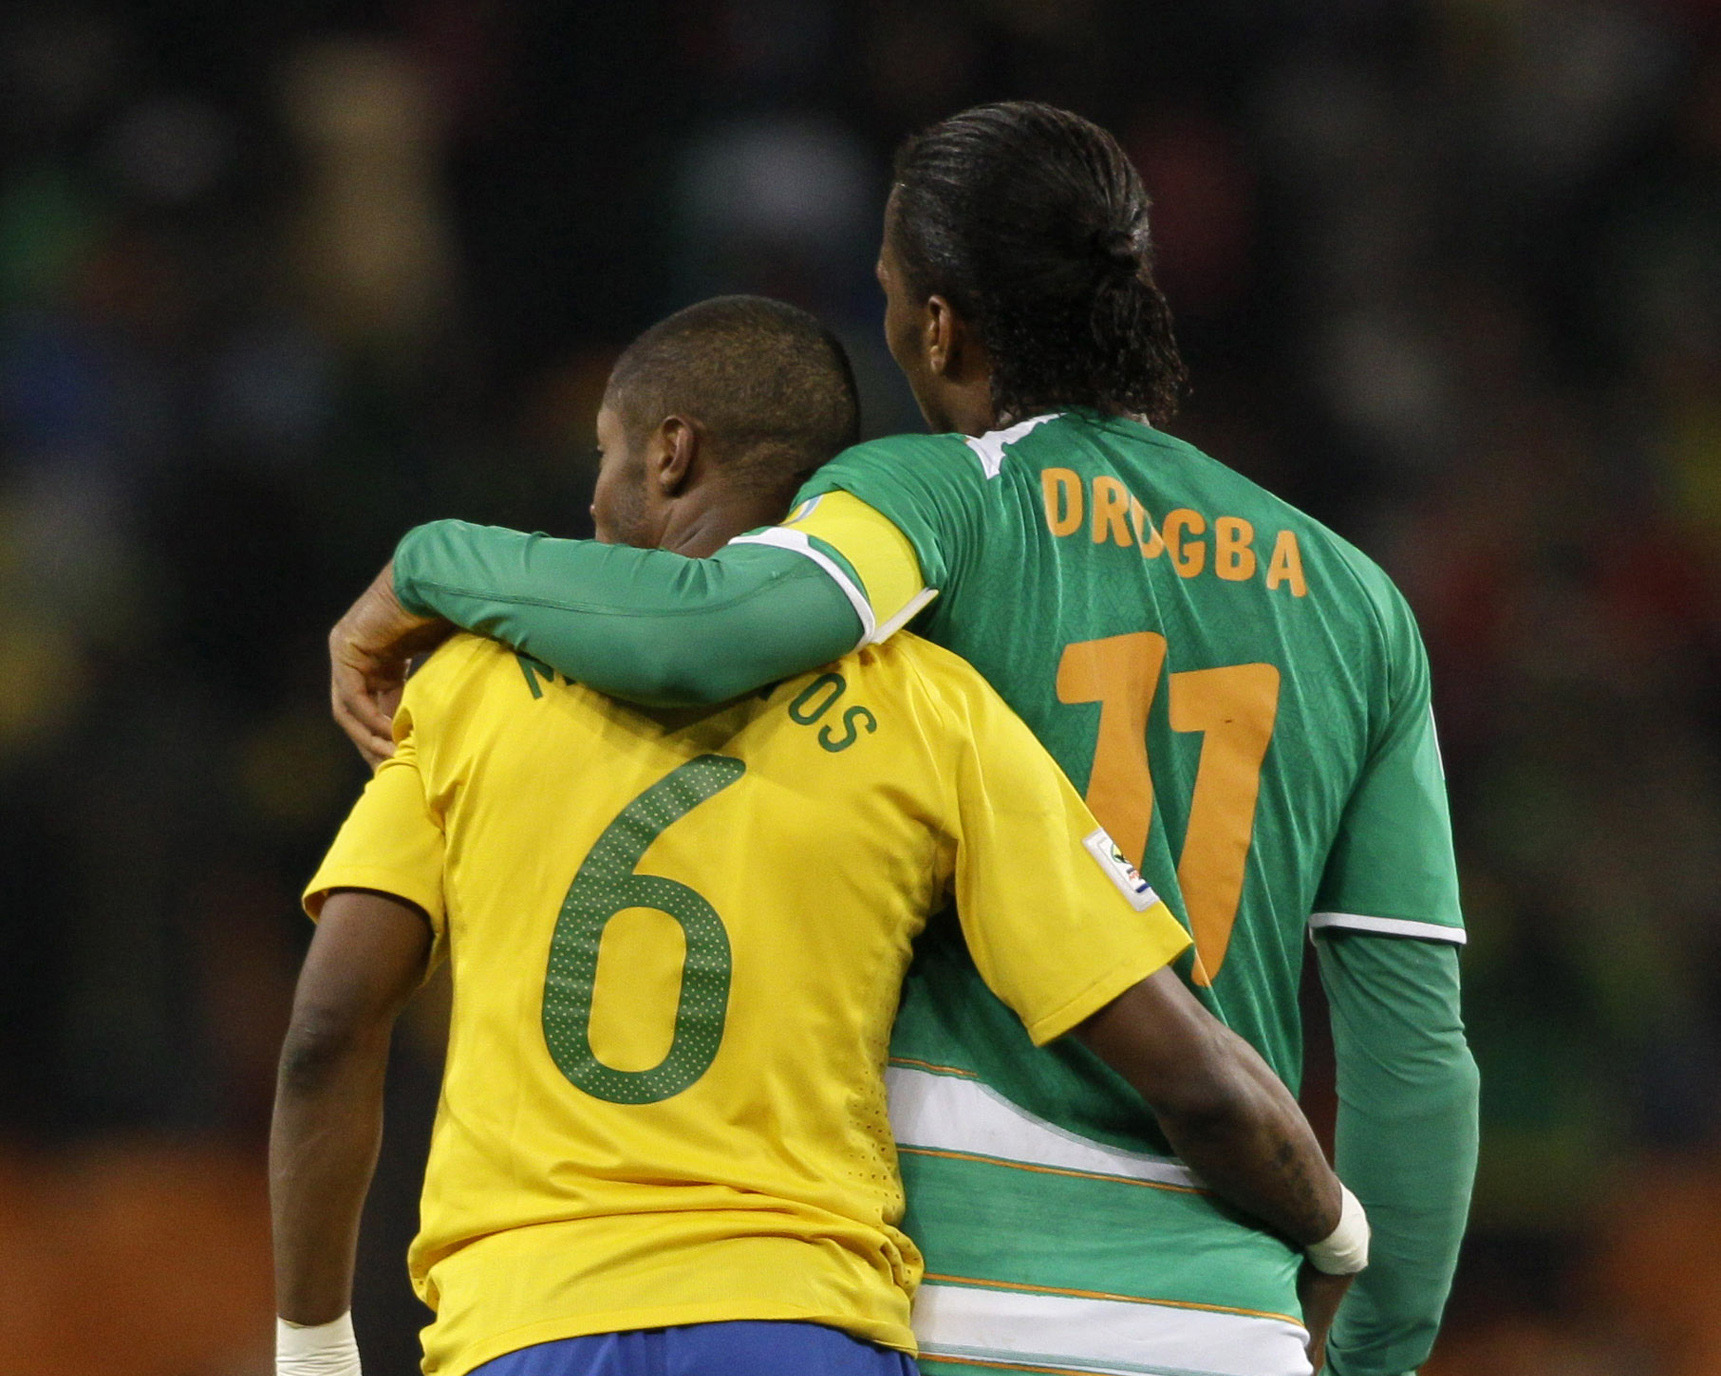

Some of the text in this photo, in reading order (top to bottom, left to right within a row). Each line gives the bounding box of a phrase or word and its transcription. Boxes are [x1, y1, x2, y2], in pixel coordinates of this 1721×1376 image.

[1041, 467, 1307, 597] DROGBA
[542, 754, 746, 1105] 6
[1055, 631, 1280, 987] 11
